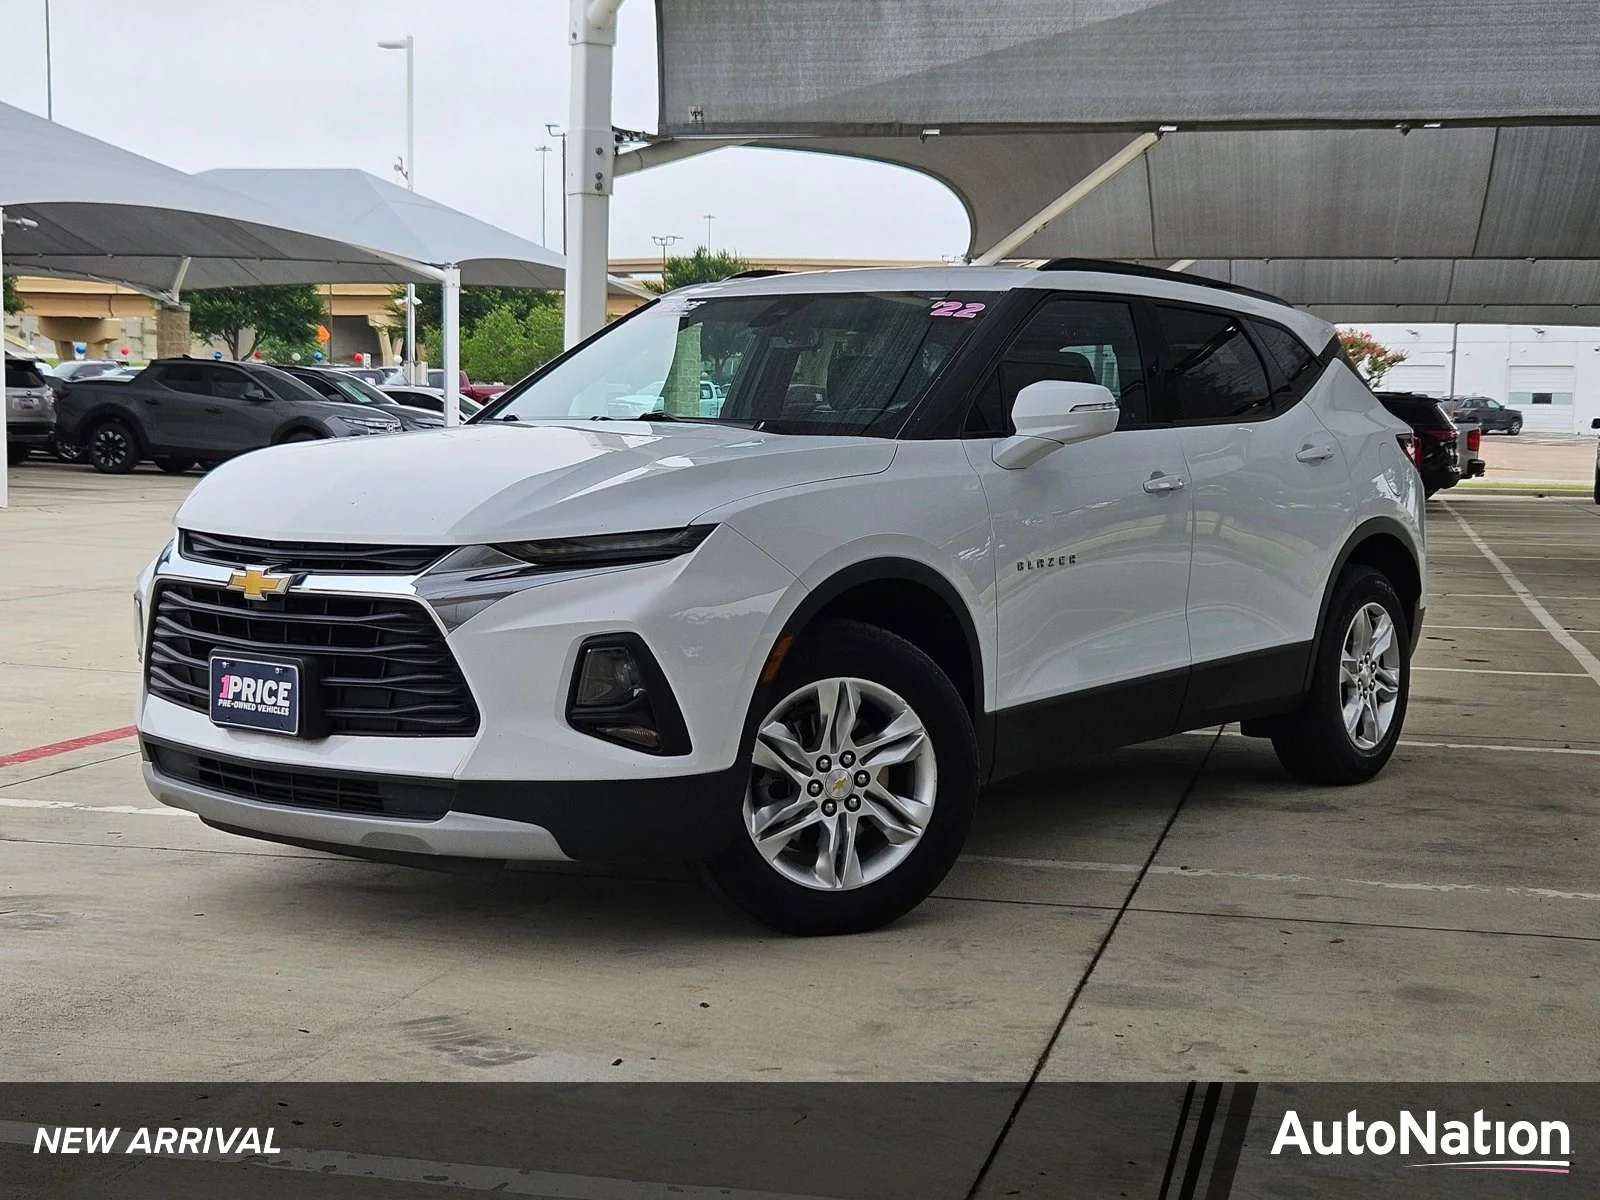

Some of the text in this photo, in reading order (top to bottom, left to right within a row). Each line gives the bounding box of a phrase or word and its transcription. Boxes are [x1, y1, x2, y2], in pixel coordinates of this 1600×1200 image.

[930, 301, 986, 318] '22
[1016, 554, 1077, 571] BLAZER
[218, 698, 290, 716] PRE-OWNED VEHICLES
